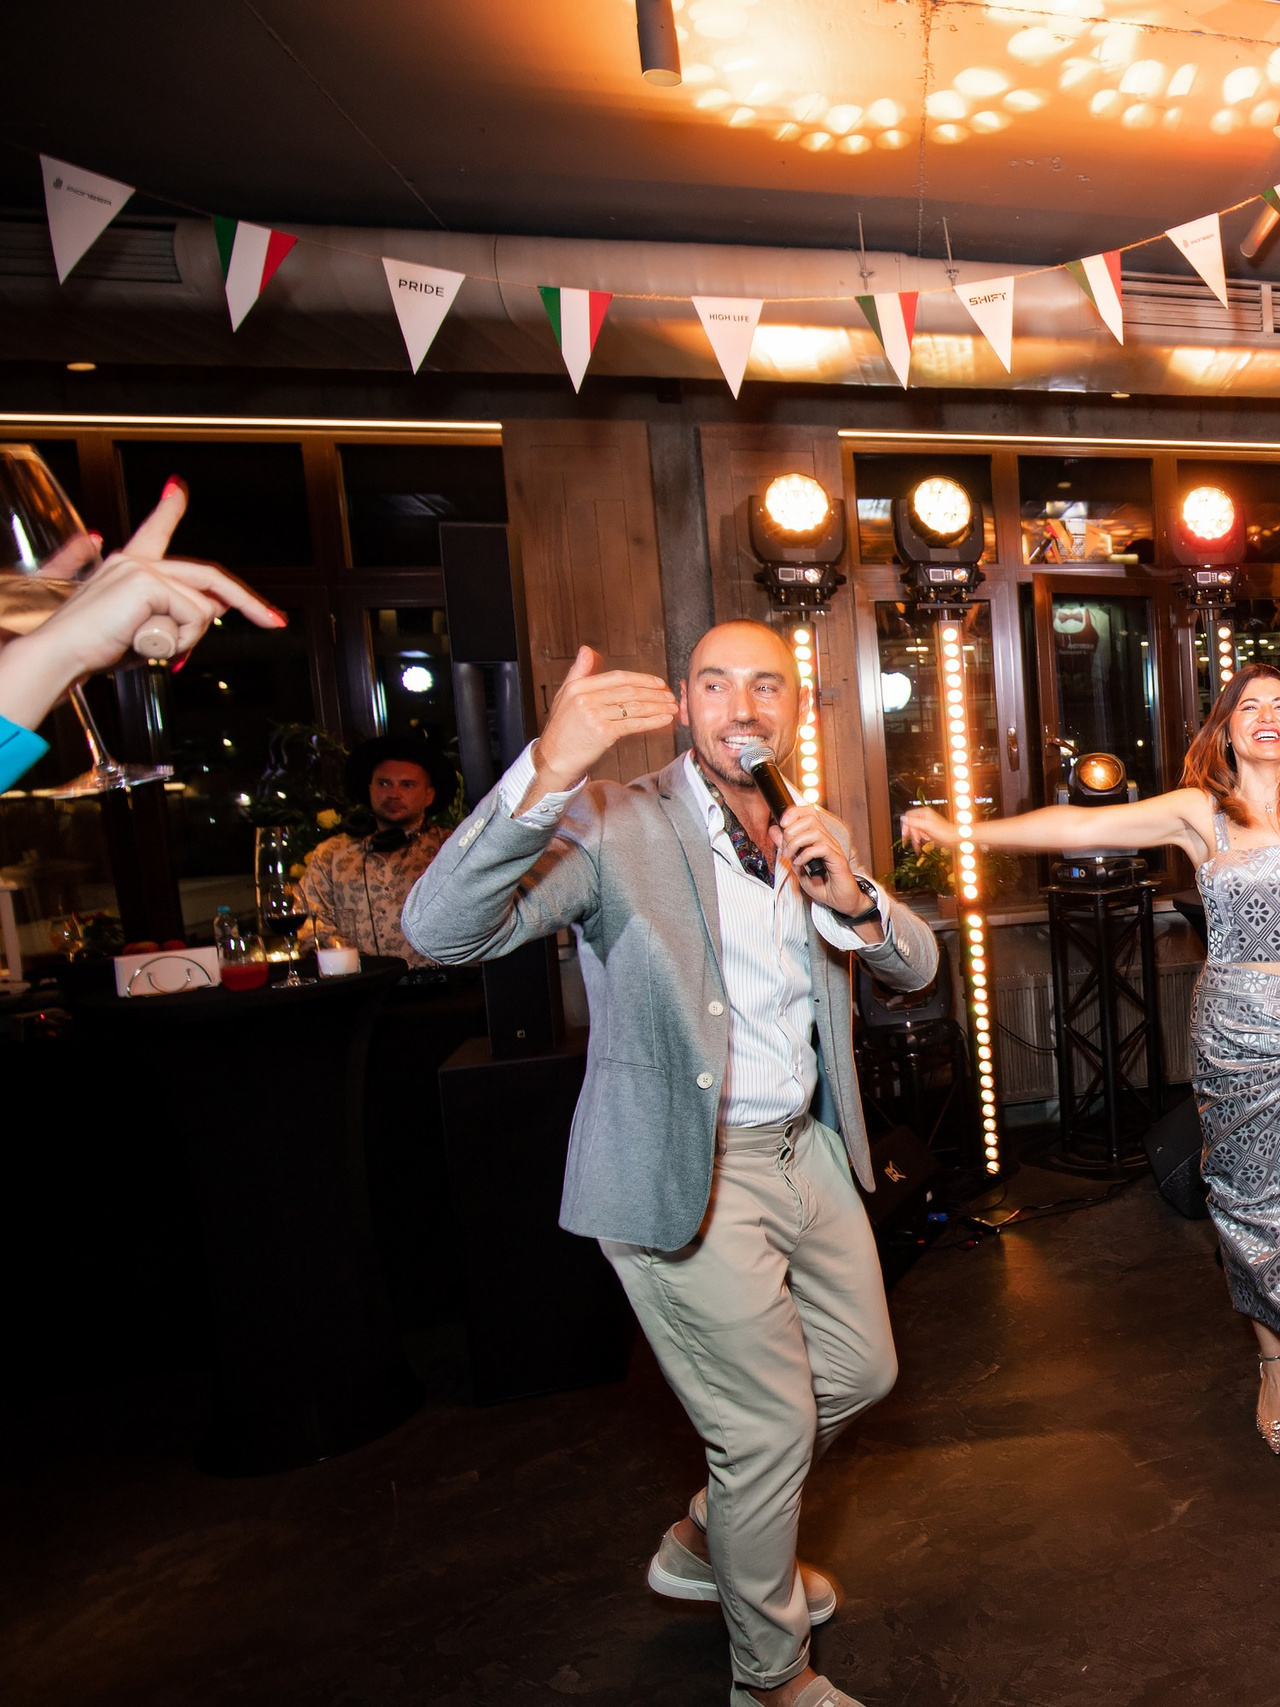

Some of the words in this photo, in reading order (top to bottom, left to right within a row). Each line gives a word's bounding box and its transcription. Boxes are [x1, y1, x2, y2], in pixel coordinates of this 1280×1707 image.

[398, 278, 445, 298] PRIDE
[968, 292, 1007, 306] SHIFT
[709, 313, 731, 321] HIGH
[732, 314, 750, 323] LIFE
